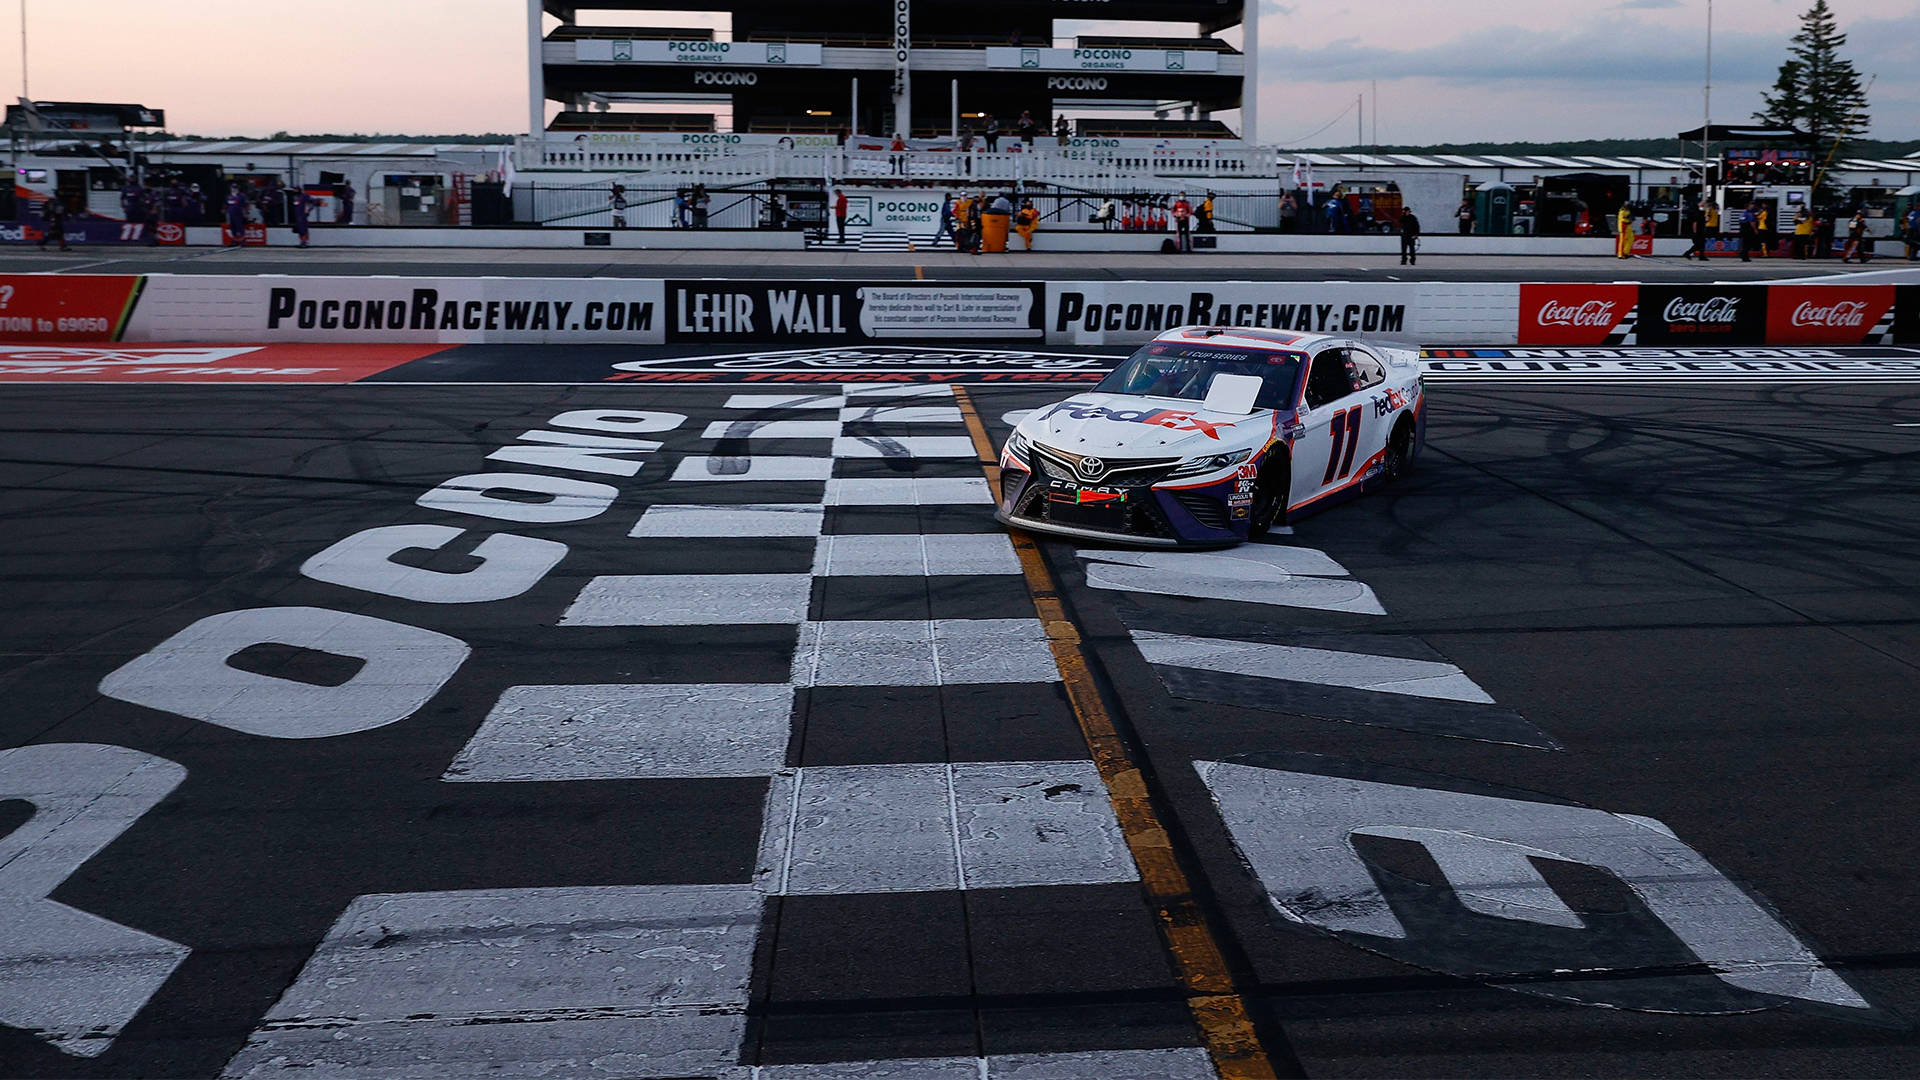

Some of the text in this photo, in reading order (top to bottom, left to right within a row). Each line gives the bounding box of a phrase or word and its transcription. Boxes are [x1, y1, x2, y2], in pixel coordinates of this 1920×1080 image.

[896, 0, 907, 62] OCONO
[669, 41, 730, 52] POCONO
[676, 54, 723, 62] ORGANICS
[1073, 49, 1132, 60] POCONO
[1081, 61, 1125, 69] ORGANICS
[694, 71, 757, 85] POCONO
[1048, 77, 1108, 90] POCONO
[796, 136, 835, 146] RODAL
[878, 201, 939, 213] POCONO
[886, 214, 932, 222] ORGANICS
[120, 223, 144, 241] 11
[677, 288, 847, 334] LEHR WALL
[1537, 300, 1617, 326] Coca-Cola
[1663, 297, 1741, 323] Coca-Cola
[1791, 301, 1868, 327] Coca-Cola
[0, 317, 108, 332] TION to 69050
[1191, 351, 1248, 361] CUP SERIES
[1428, 360, 1601, 372] CUP
[602, 372, 729, 382] THE
[740, 372, 967, 382] TRICKY
[1039, 401, 1236, 440] FedEx
[1321, 404, 1362, 486] 11
[1238, 464, 1257, 478] 3M
